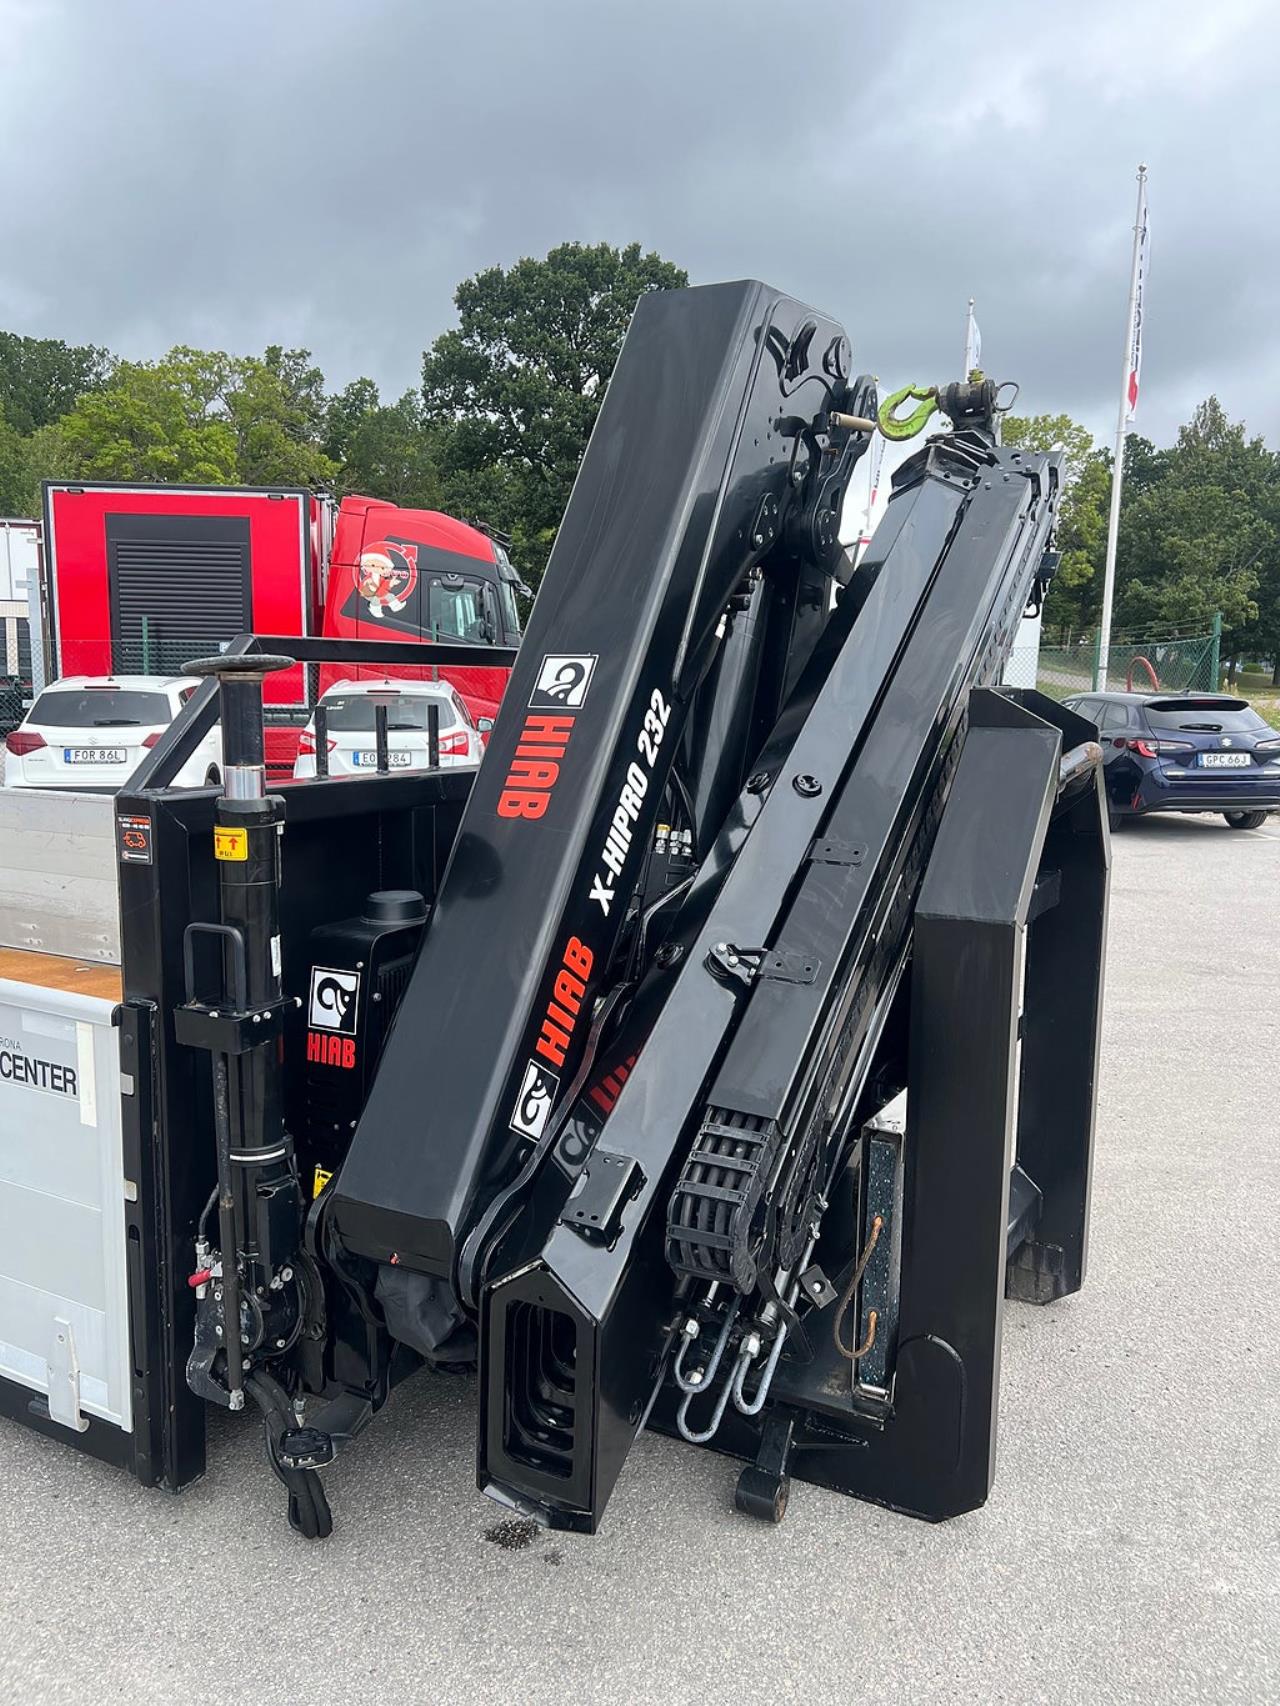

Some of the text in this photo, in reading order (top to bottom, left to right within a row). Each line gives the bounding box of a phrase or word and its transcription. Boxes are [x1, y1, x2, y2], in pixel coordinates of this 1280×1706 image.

[74, 751, 121, 761] FOR 86L
[496, 715, 576, 821] HIAB
[1206, 755, 1247, 764] GPC 66J
[589, 688, 671, 916] X-HIPRO 232
[536, 936, 594, 1067] HIAB
[307, 1032, 356, 1069] HIAB
